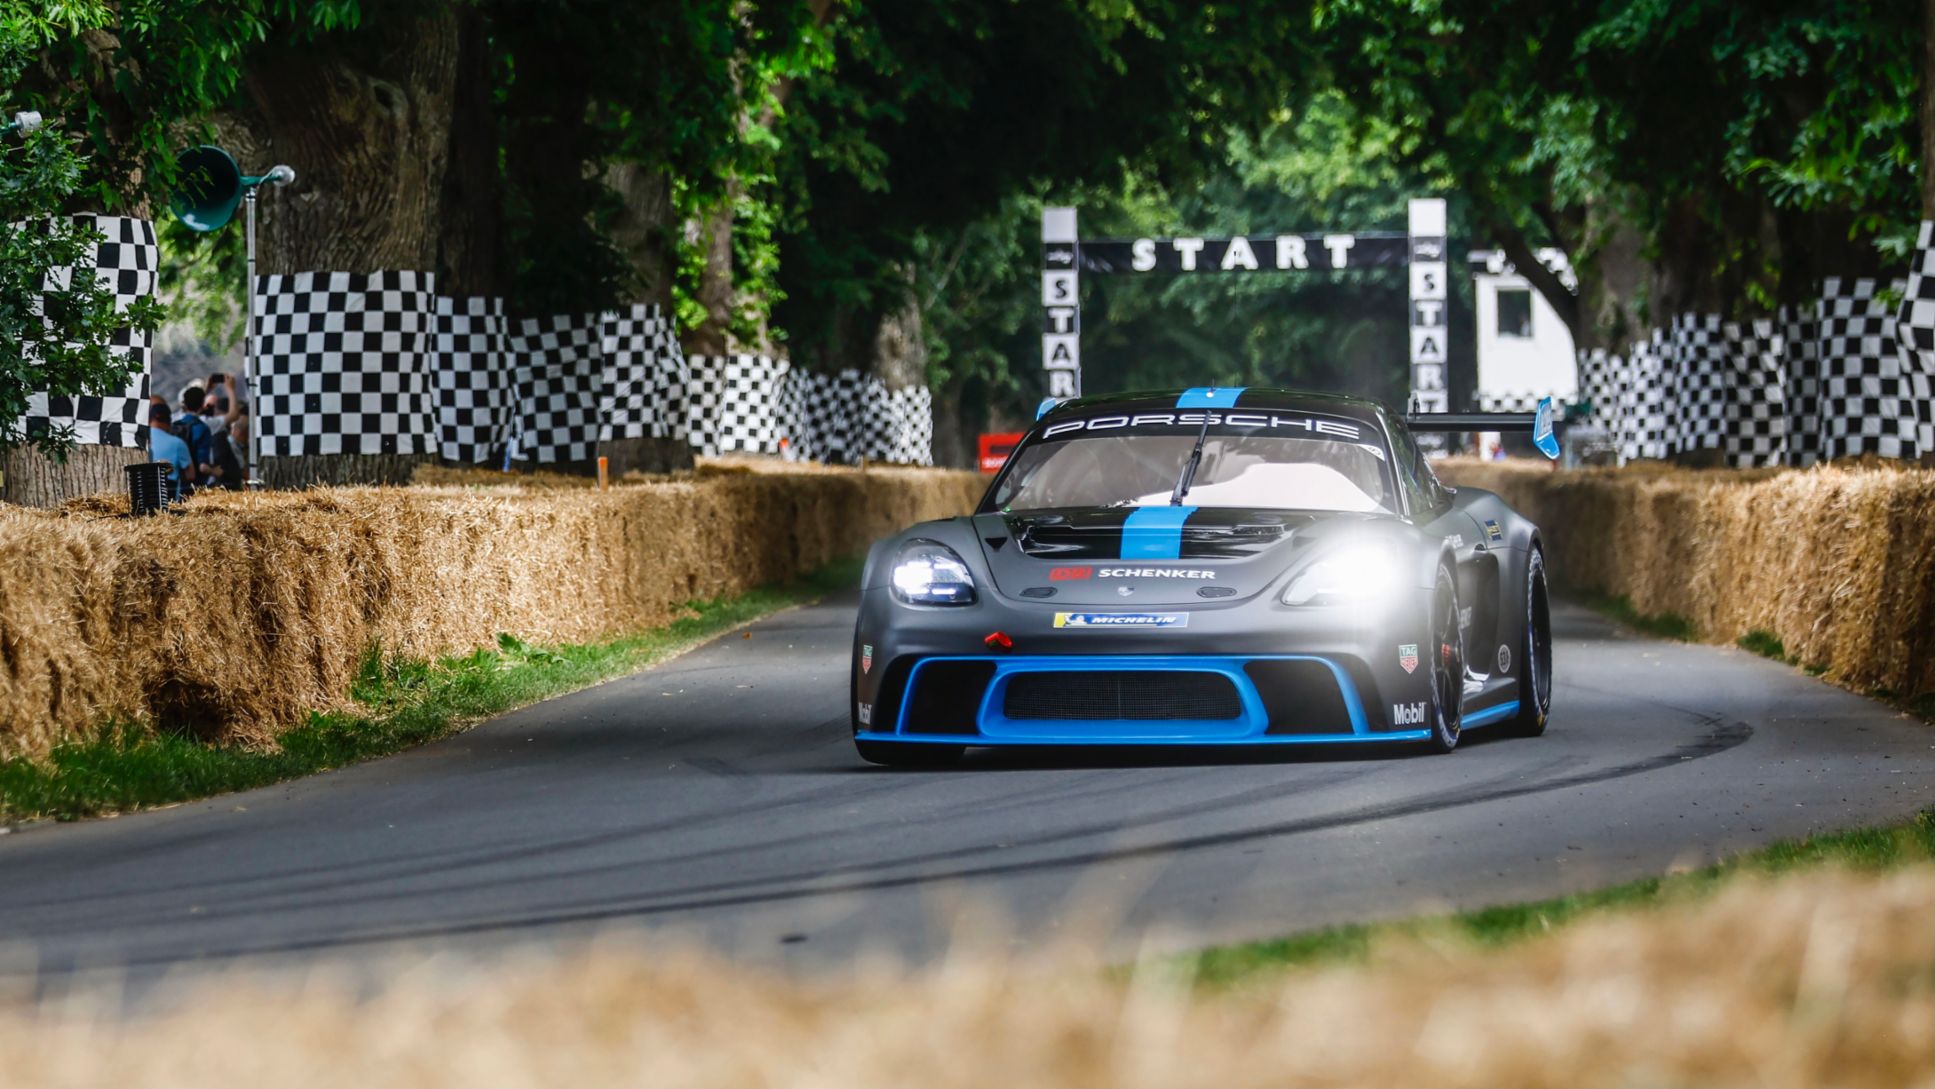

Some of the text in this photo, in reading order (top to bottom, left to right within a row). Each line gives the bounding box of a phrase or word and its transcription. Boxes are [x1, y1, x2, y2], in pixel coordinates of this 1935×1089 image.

[1131, 234, 1355, 272] START
[1047, 279, 1076, 398] STAR
[1415, 272, 1443, 413] START
[1042, 414, 1360, 440] PORSCHE
[1098, 568, 1217, 580] SCHENKER
[1091, 615, 1177, 625] MICHELIN
[1400, 646, 1417, 657] TAG
[1393, 702, 1425, 725] Mobil
